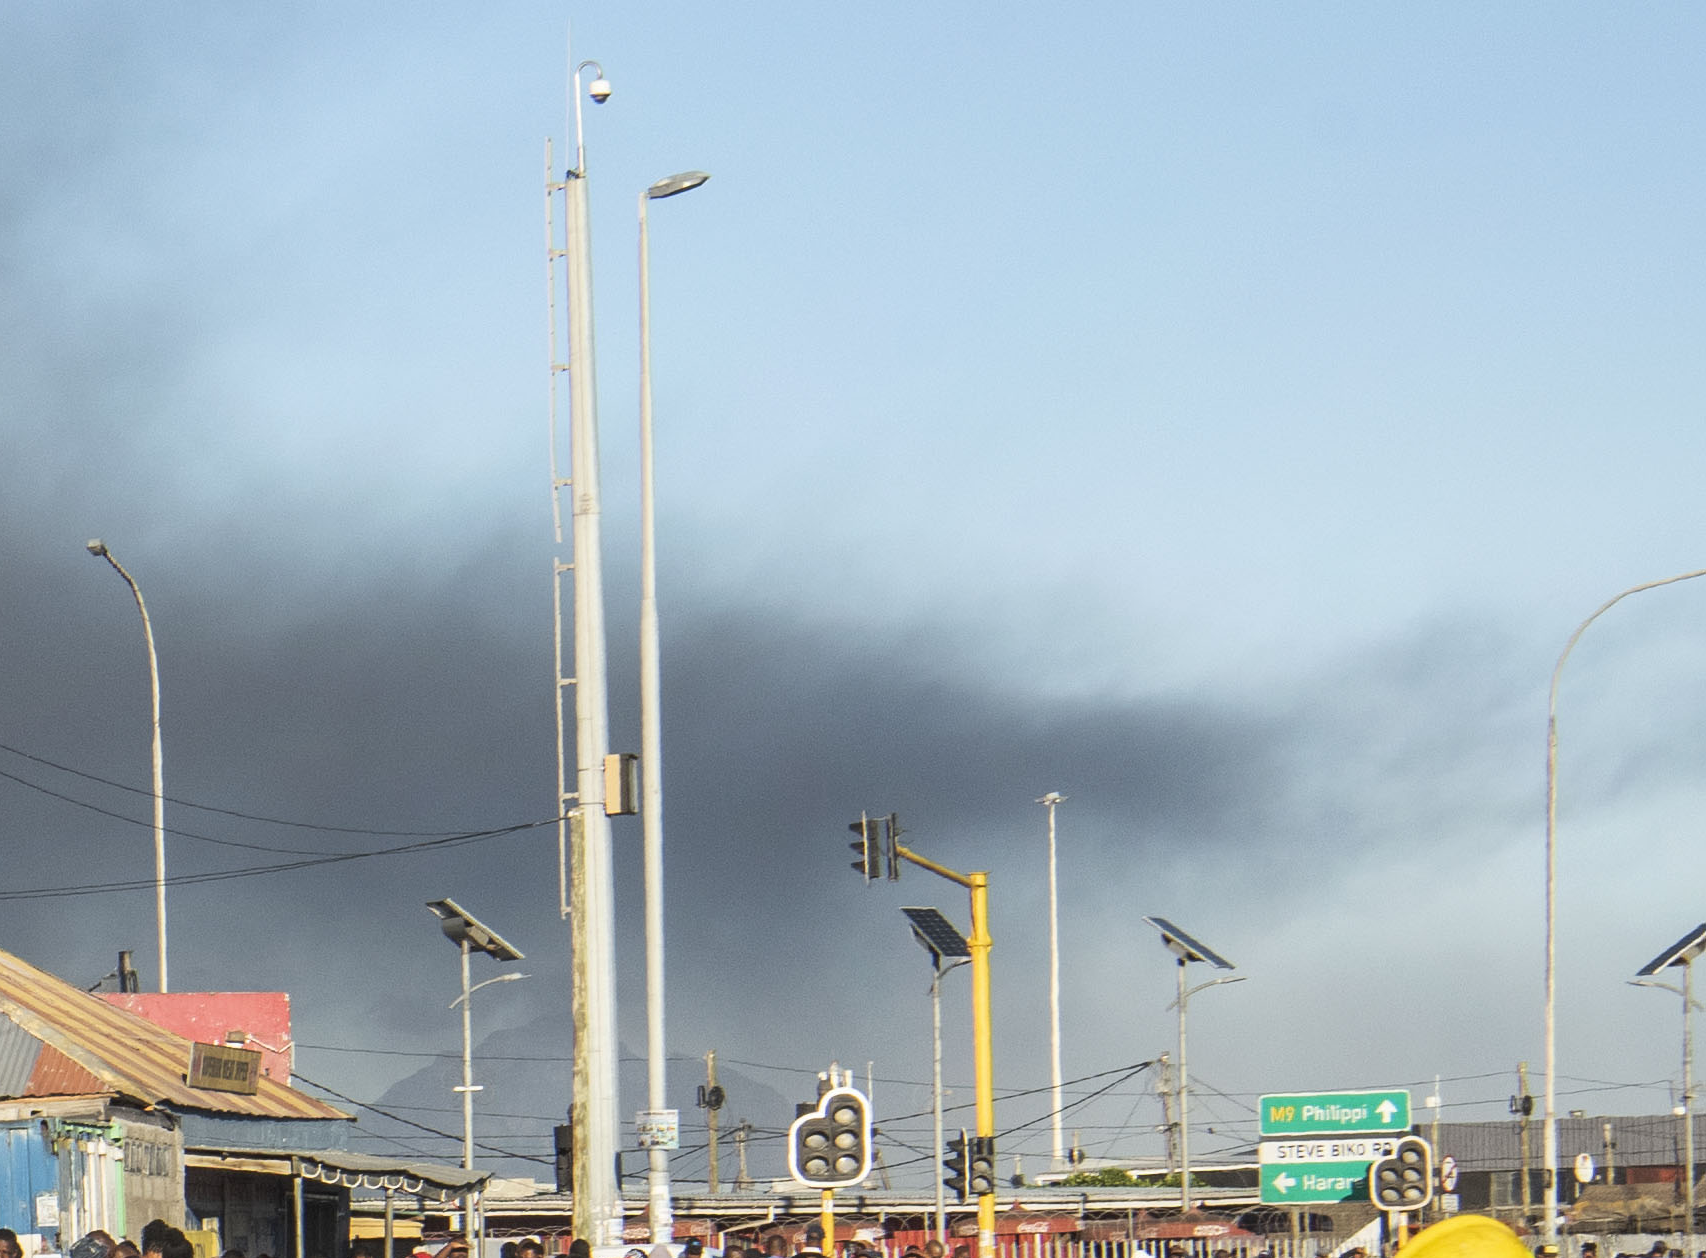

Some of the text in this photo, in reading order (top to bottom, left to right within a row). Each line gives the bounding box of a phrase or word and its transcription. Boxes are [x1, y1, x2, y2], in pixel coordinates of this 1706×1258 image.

[1270, 1104, 1367, 1124] M9 Philippi
[1277, 1144, 1325, 1159] STEVE
[1331, 1142, 1366, 1157] BIKO
